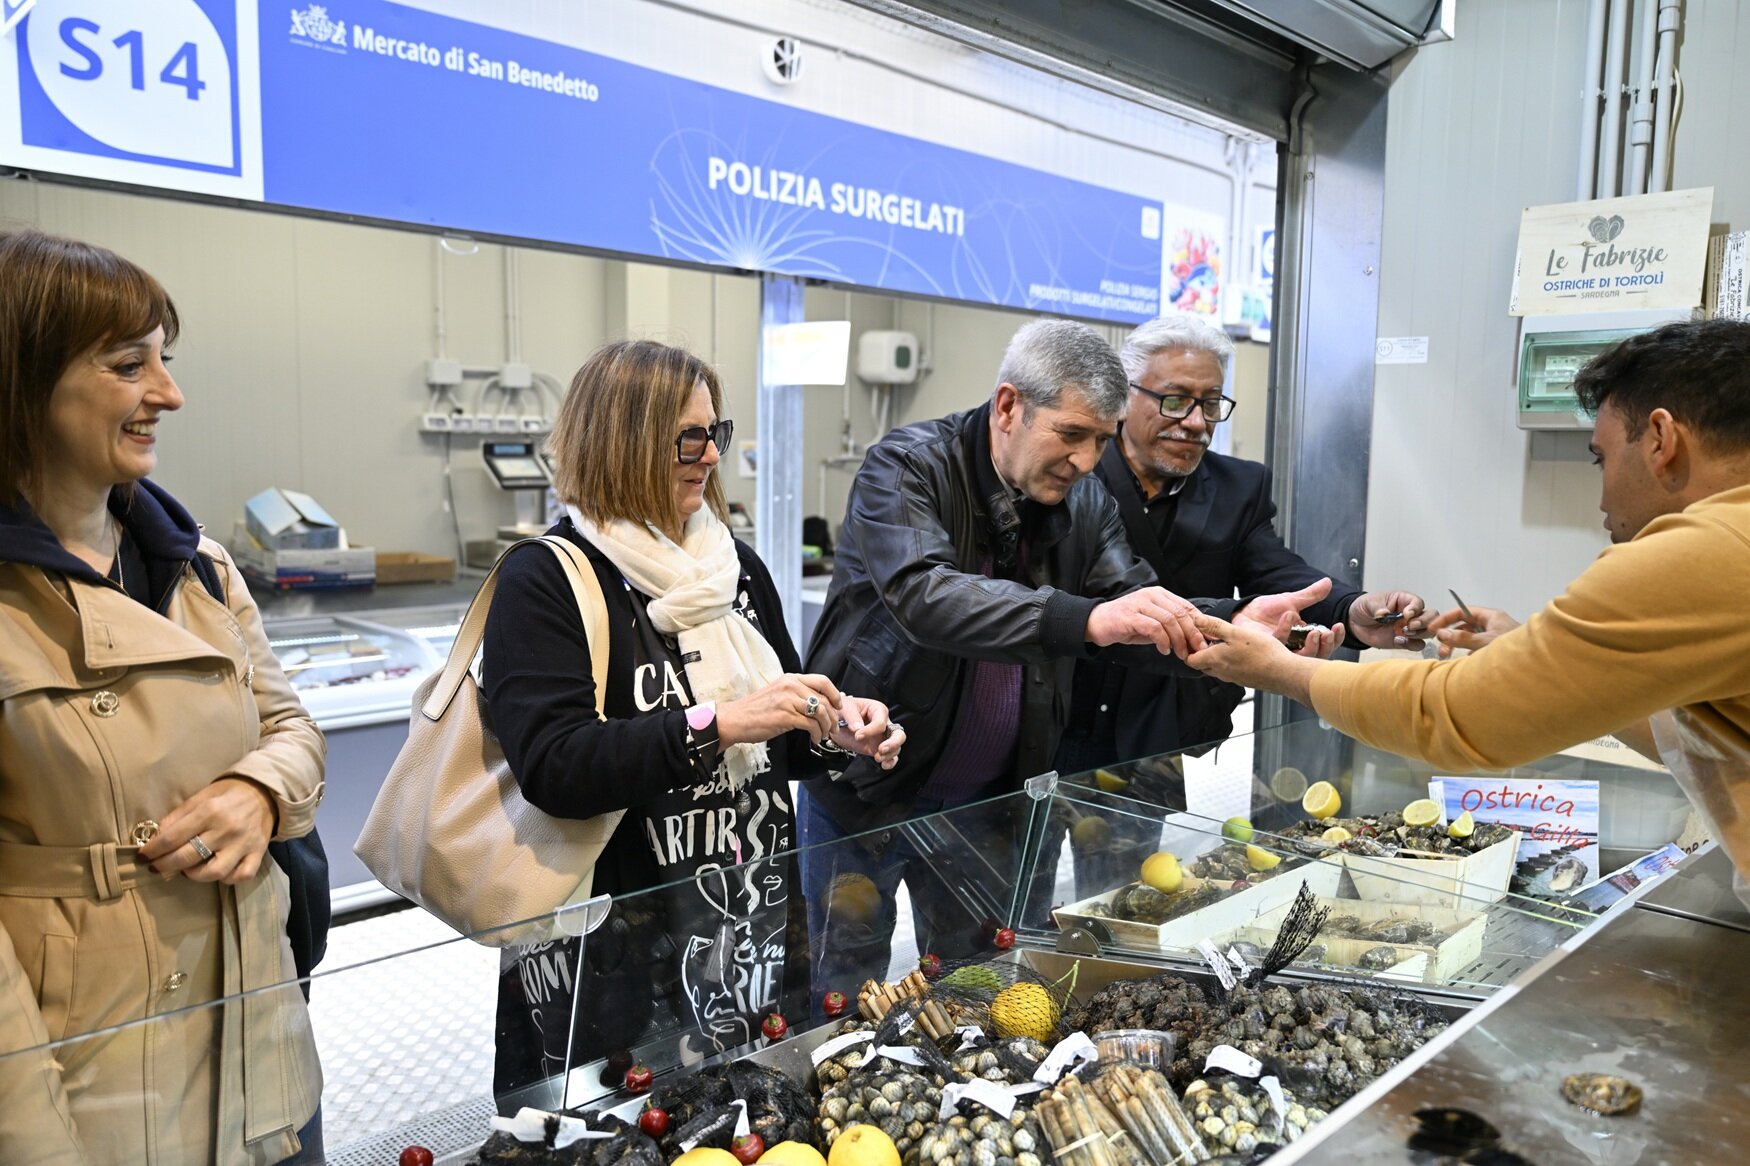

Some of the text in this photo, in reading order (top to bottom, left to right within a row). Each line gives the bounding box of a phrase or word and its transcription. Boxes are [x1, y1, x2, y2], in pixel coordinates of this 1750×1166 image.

[58, 17, 206, 101] S14
[353, 25, 441, 67] Mercato
[444, 46, 464, 72] di
[467, 52, 503, 80] San
[507, 60, 599, 102] Benedetto
[708, 156, 964, 237] POLIZIA SURGELATI
[1545, 243, 1668, 277] Le Fabrizie
[1543, 271, 1664, 292] OSTRICHE DI TORTOLÌ
[1580, 290, 1620, 299] SARDEGNA
[1461, 784, 1575, 817] Ostrica
